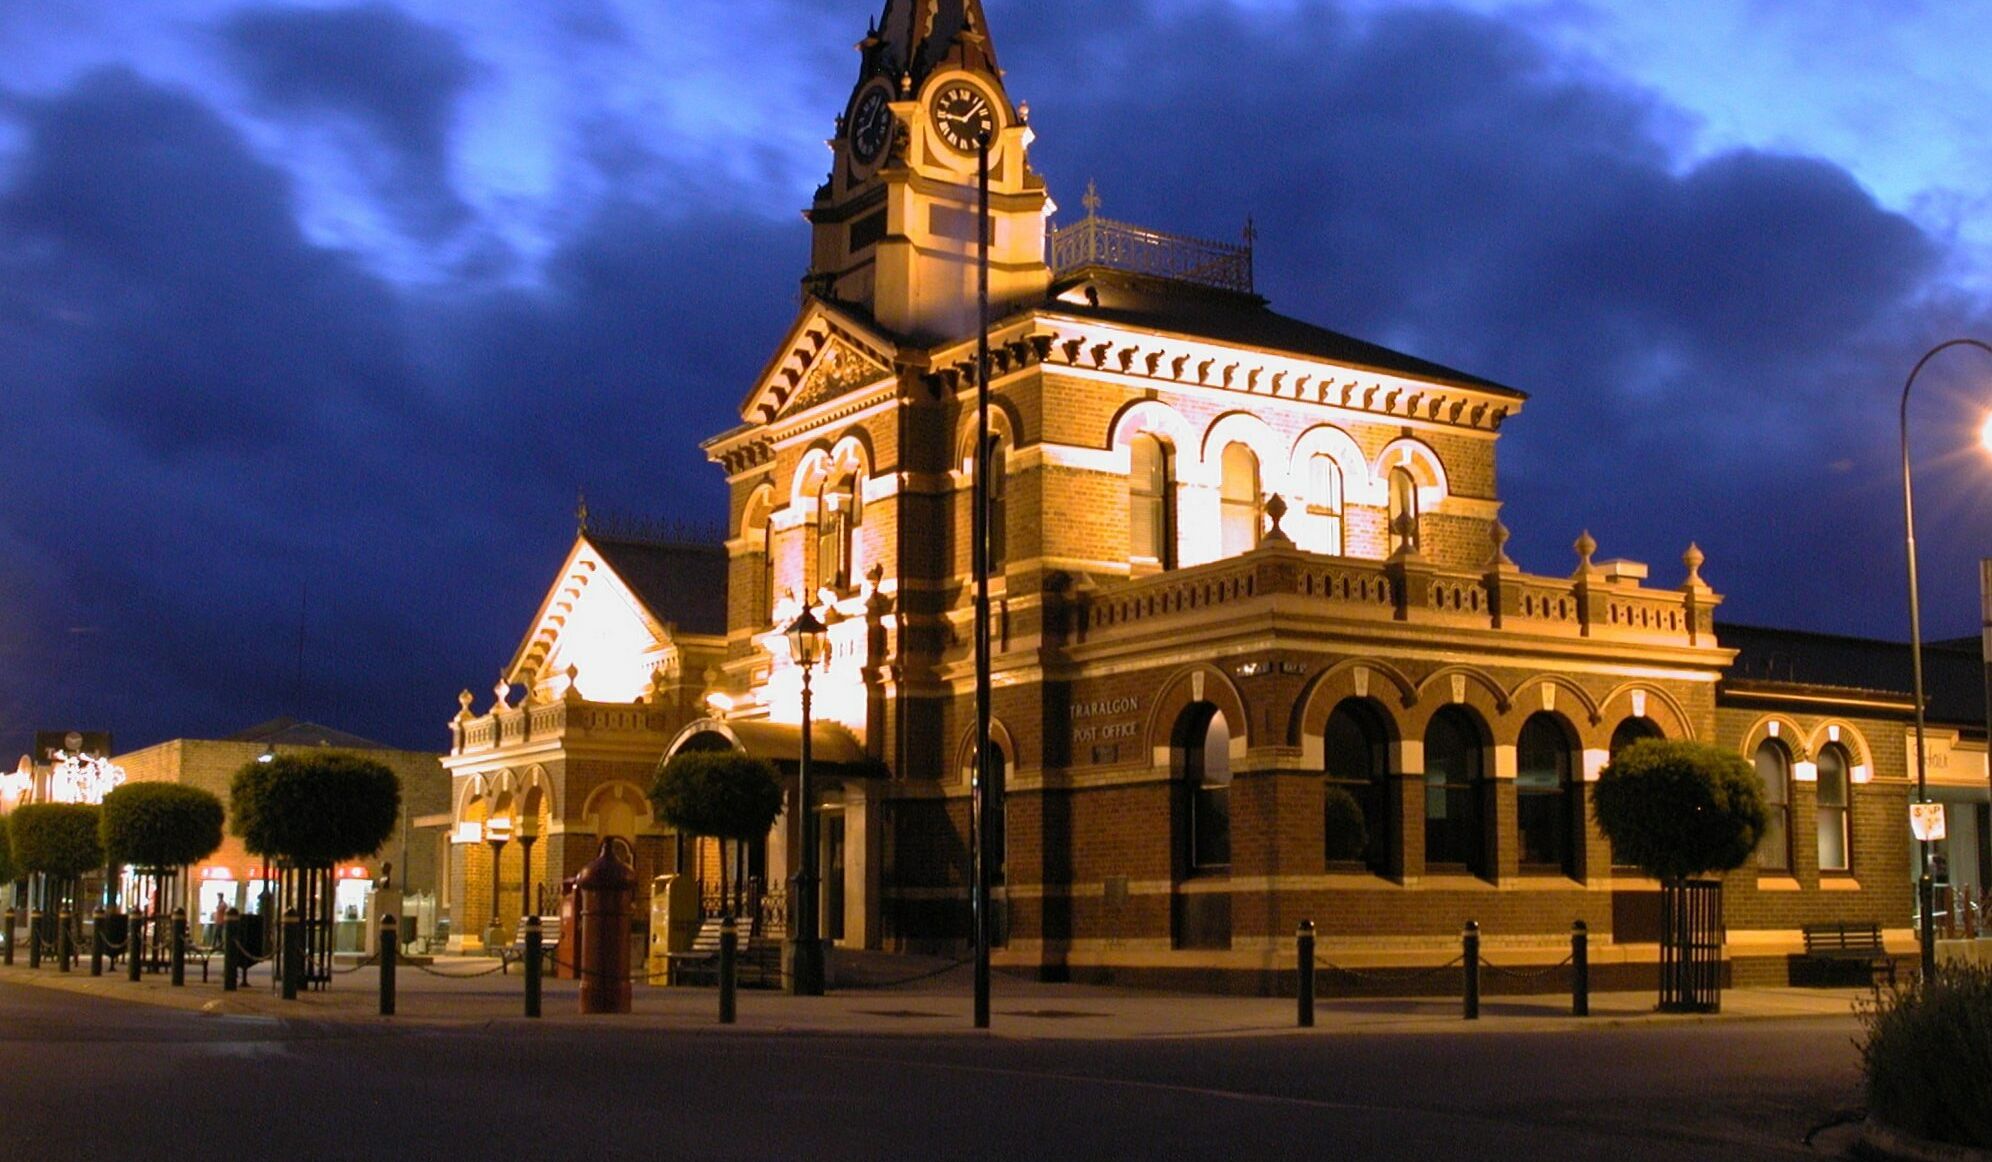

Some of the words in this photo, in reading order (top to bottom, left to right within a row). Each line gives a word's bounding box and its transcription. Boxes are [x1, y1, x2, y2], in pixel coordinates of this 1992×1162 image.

[1070, 696, 1138, 719] TRARALGON
[1074, 727, 1096, 742] POST
[1103, 722, 1137, 738] OFFICE
